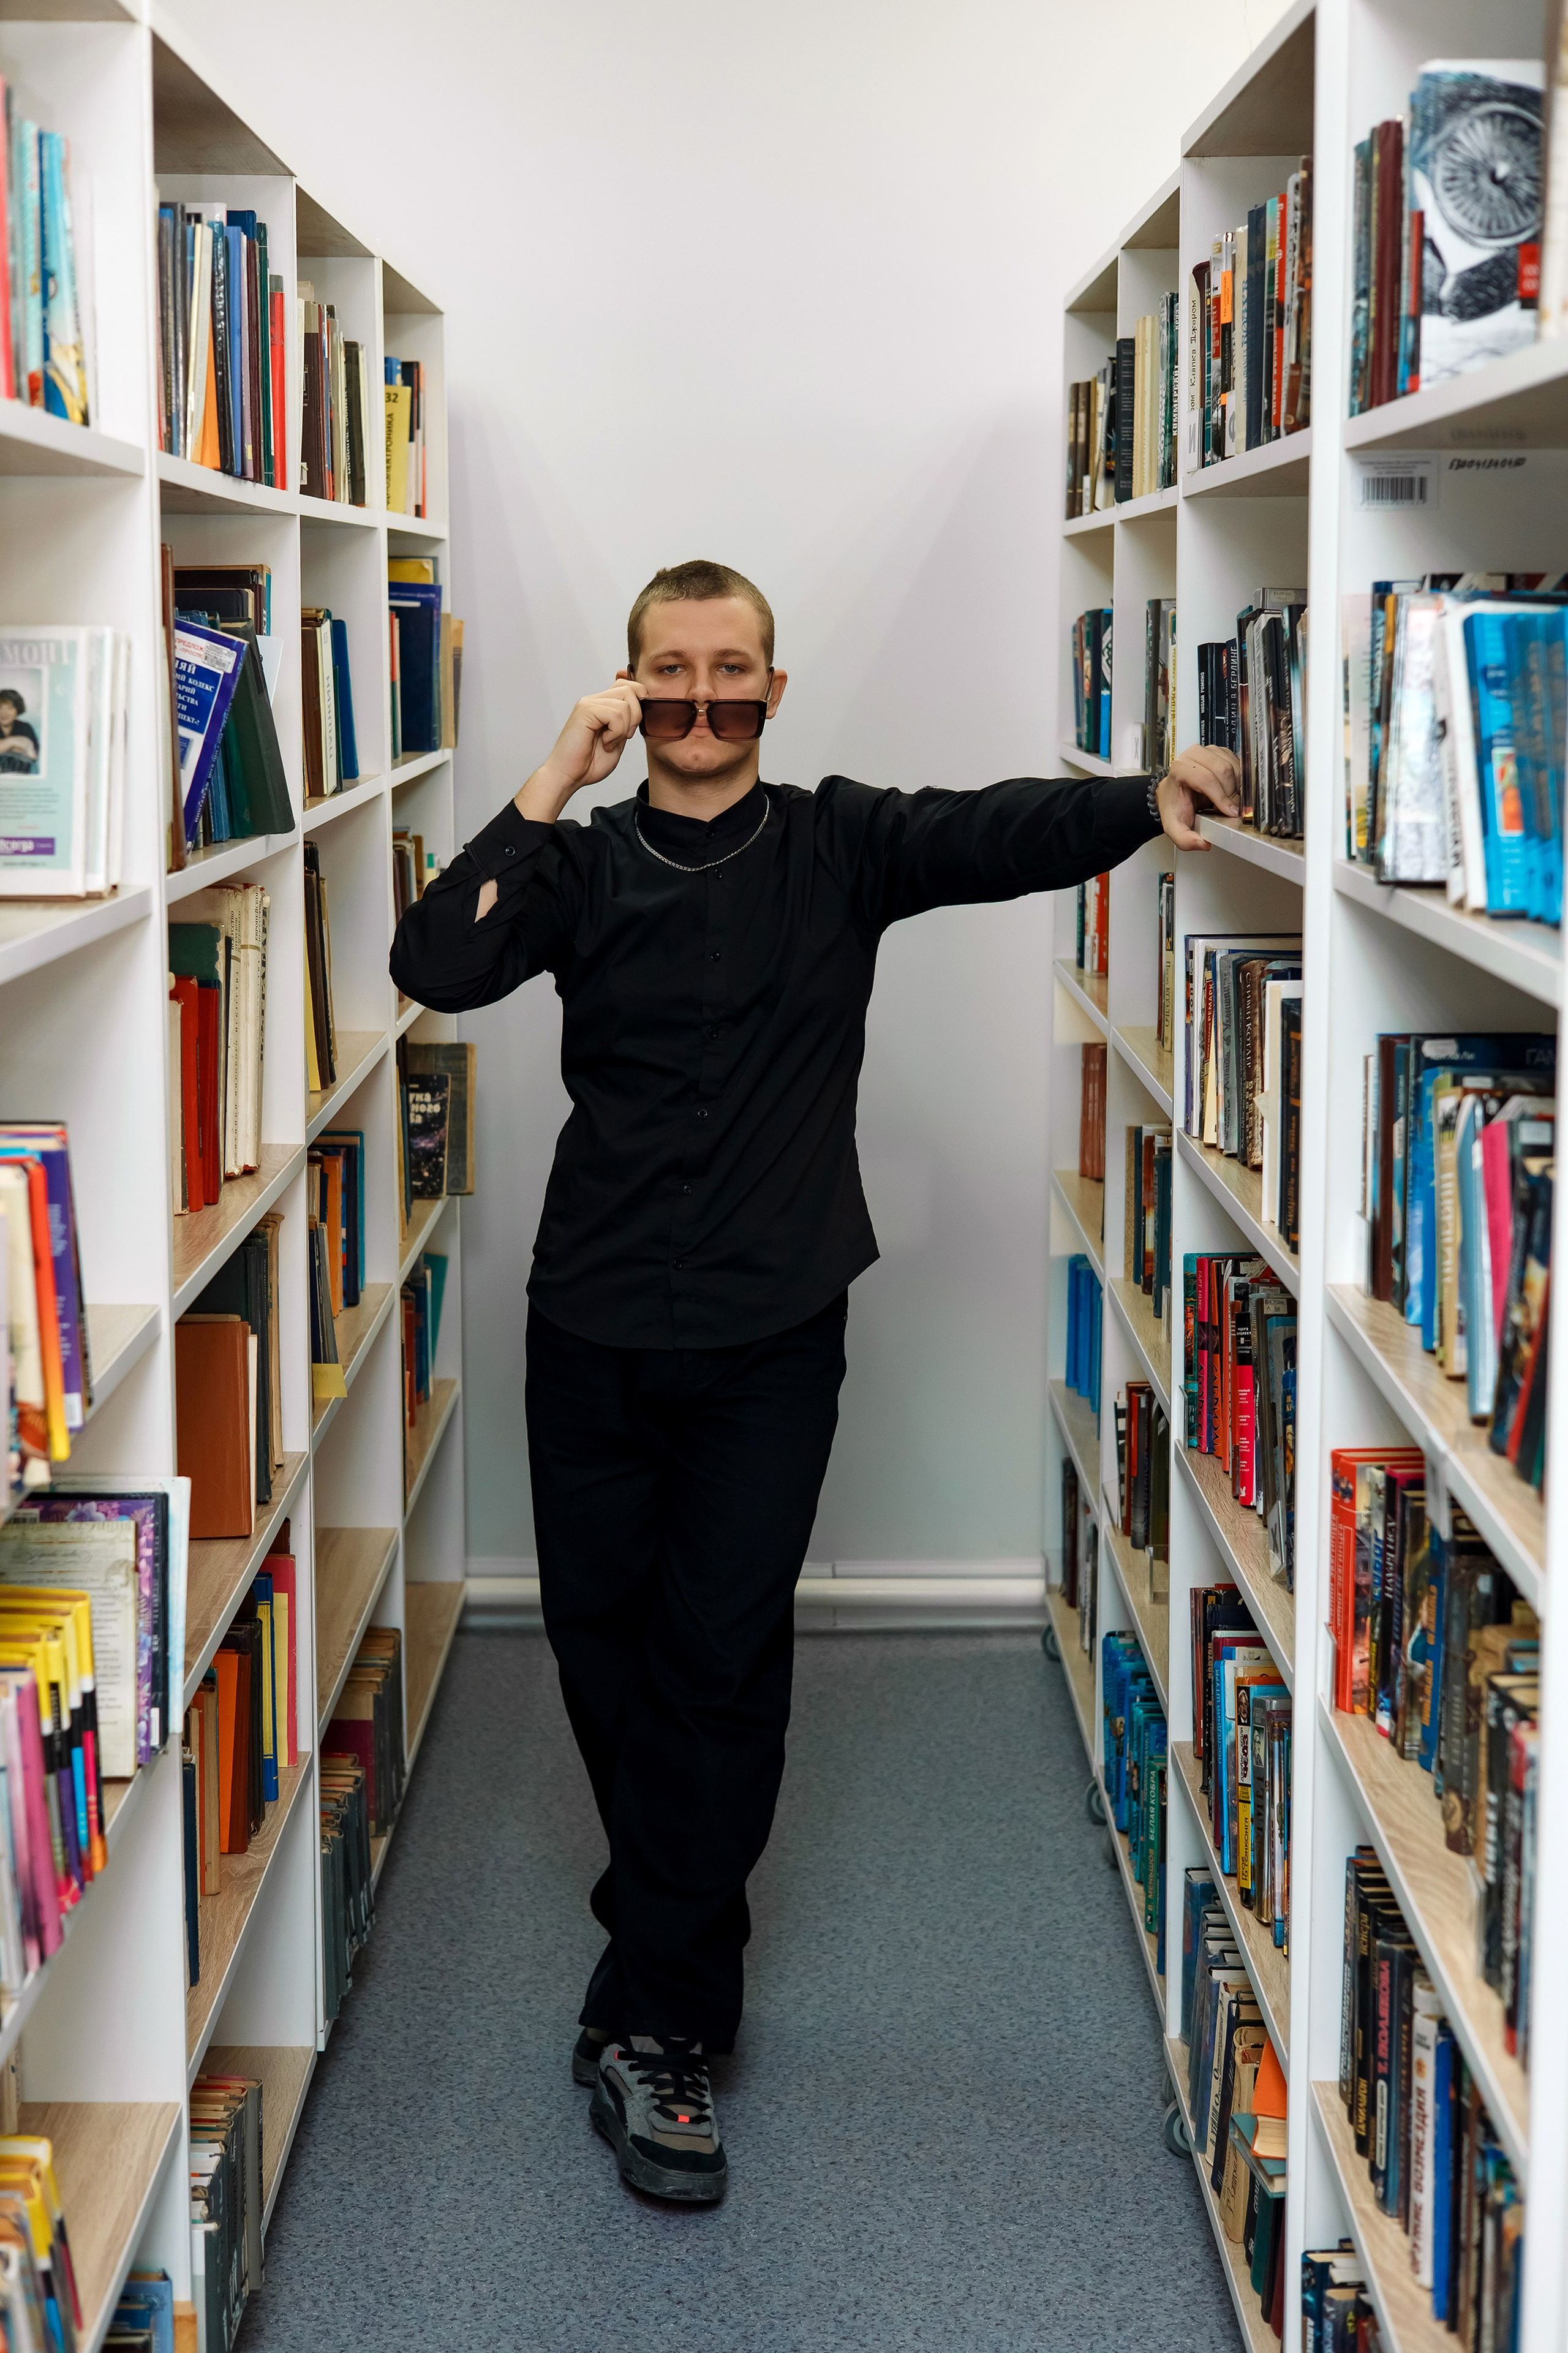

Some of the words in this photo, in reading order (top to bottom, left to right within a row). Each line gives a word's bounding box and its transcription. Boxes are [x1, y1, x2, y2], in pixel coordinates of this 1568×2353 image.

[187, 676, 215, 693] КОДЕКС
[326, 676, 335, 758] ПУШКИН
[1384, 1552, 1395, 1598] БРАУН
[1244, 1870, 1248, 1881] ИЗ
[1377, 1960, 1390, 2059] ПОЛЯКОВА
